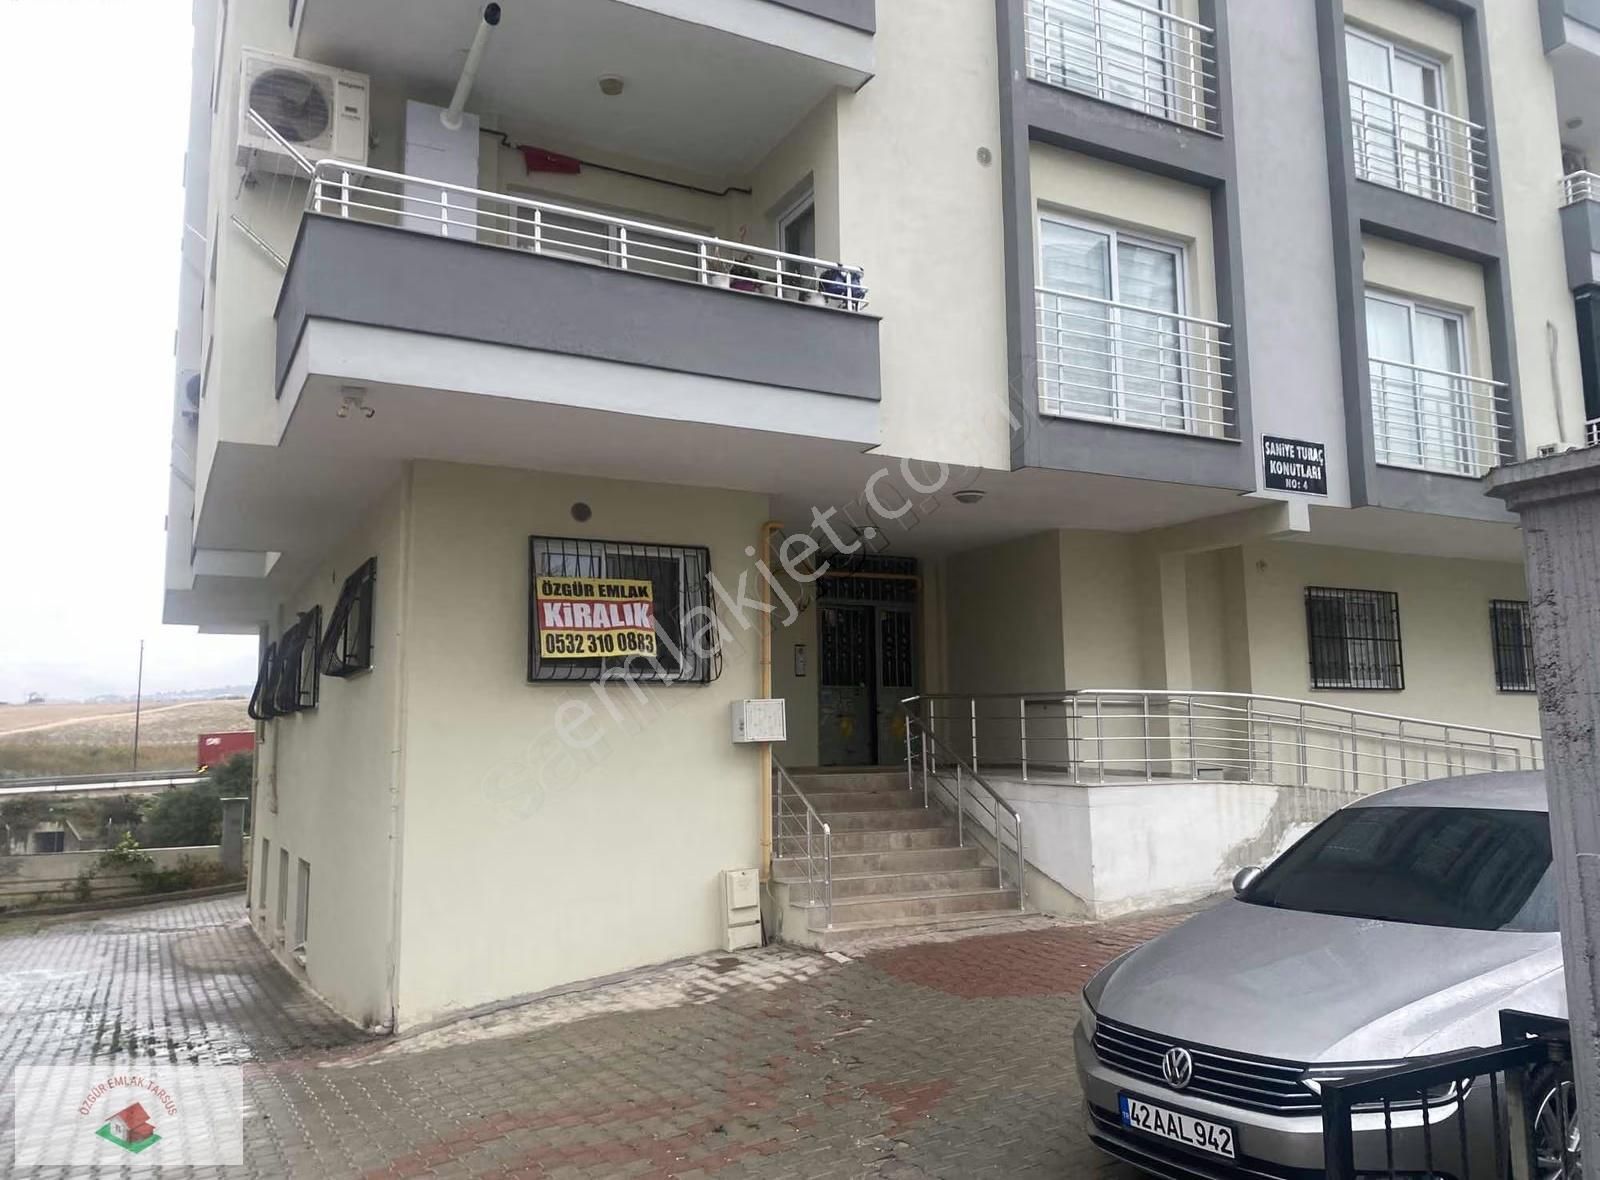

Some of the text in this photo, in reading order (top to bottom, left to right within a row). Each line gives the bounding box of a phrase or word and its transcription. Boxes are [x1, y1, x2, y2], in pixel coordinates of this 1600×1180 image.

[1270, 460, 1321, 480] KONUTLARI
[542, 580, 649, 598] ÖZGÜR EMLAK
[545, 631, 654, 654] 0532 310 0883
